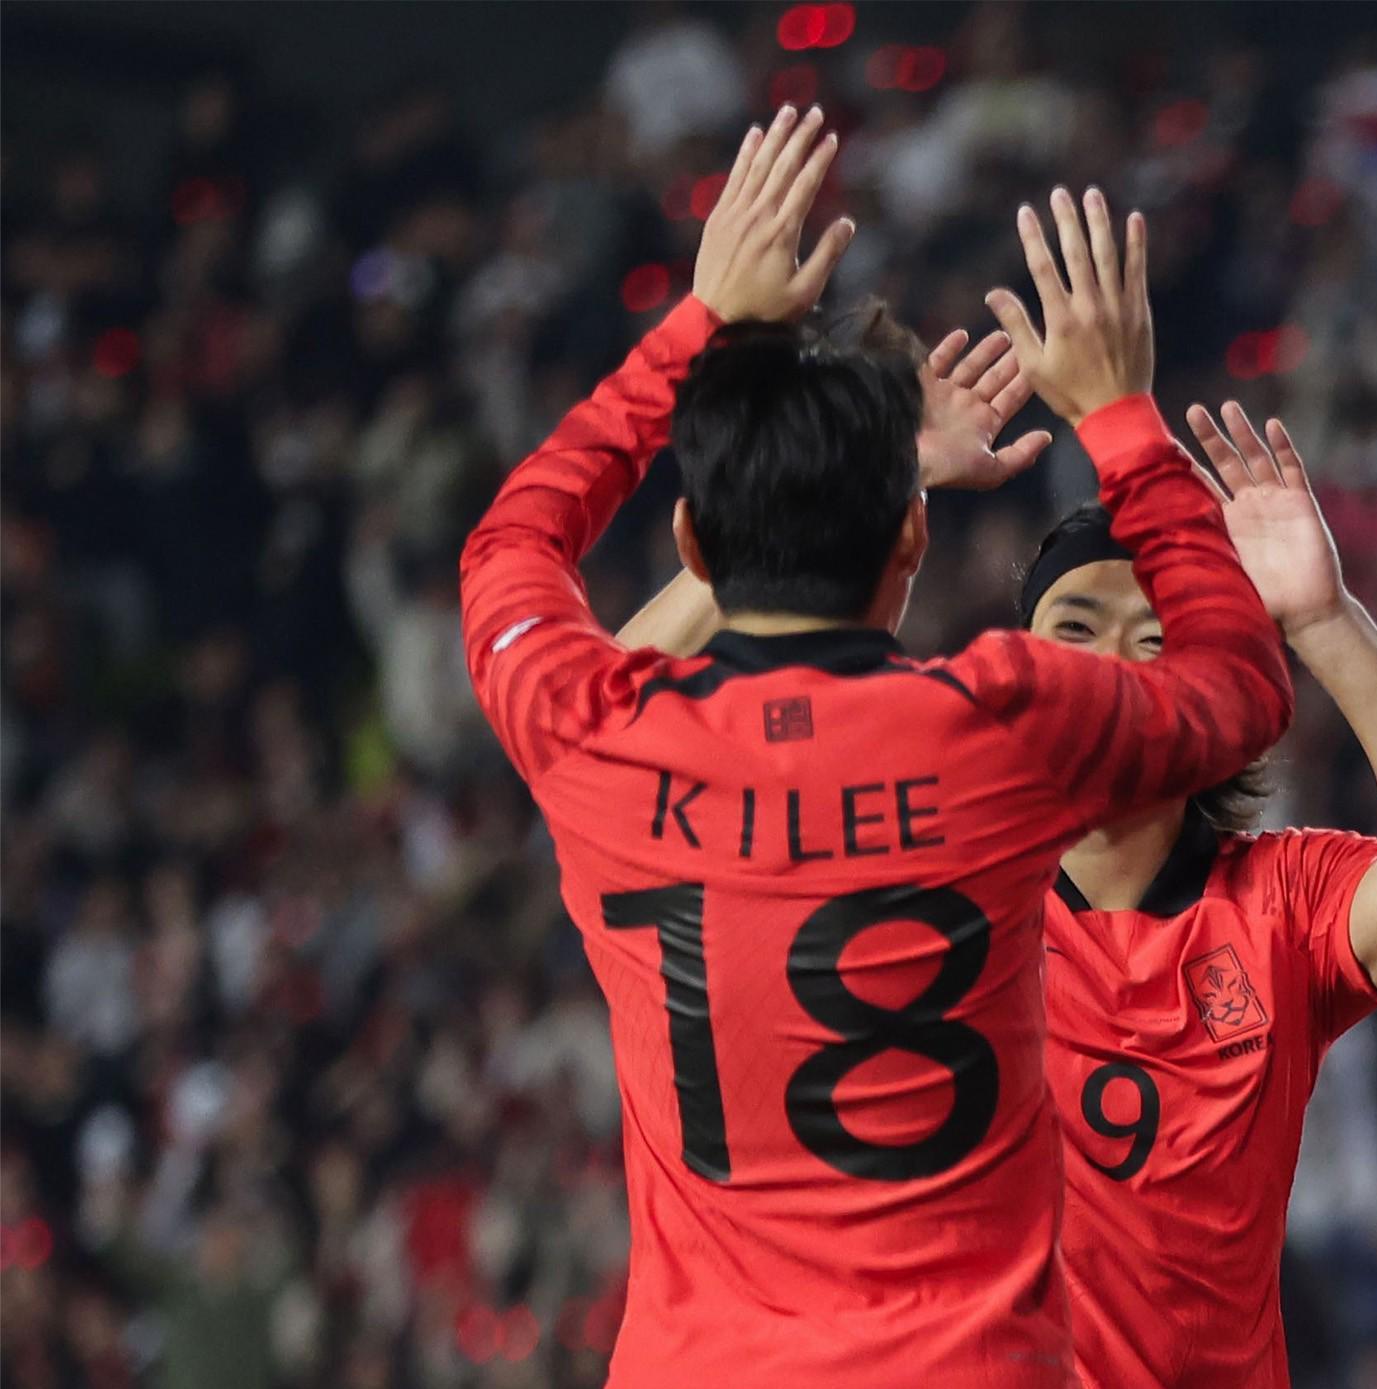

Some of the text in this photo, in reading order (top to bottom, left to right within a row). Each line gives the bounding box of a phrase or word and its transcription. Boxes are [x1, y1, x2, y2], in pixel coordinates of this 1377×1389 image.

[601, 883, 1001, 1184] 18
[1218, 1032, 1276, 1060] KOREA
[1080, 1062, 1161, 1182] 9
